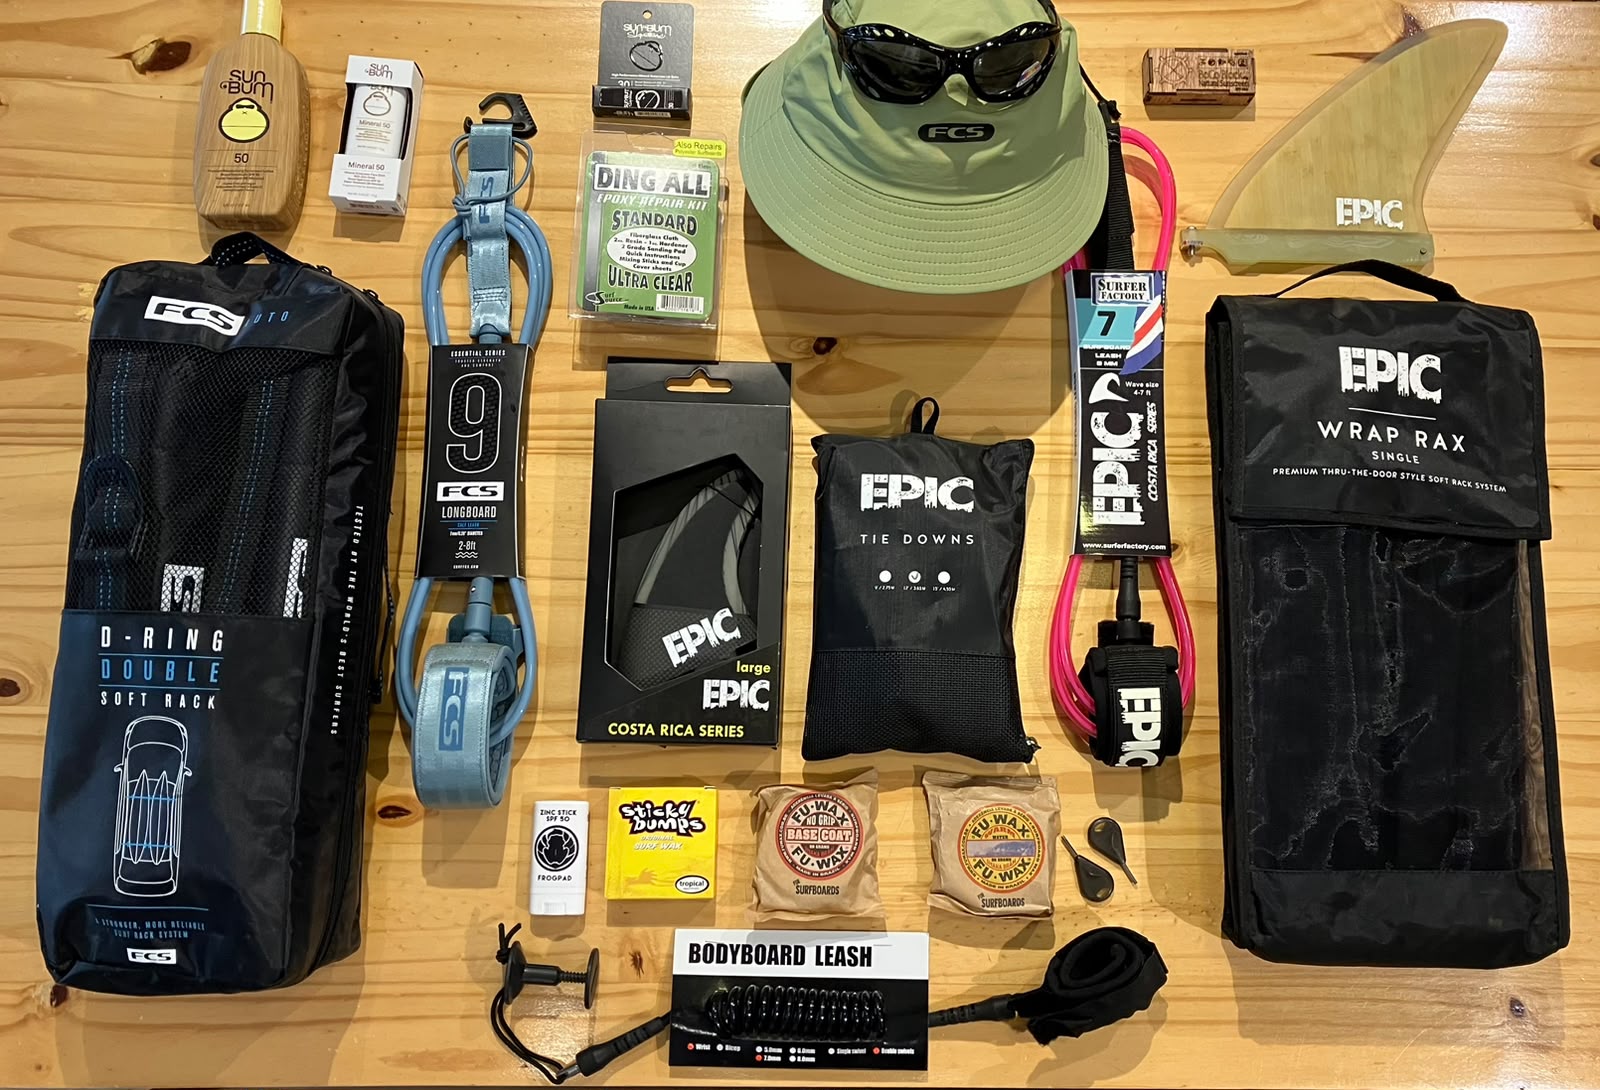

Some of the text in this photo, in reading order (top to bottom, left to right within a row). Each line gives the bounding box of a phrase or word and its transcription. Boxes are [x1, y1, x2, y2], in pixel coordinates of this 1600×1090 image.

[359, 119, 381, 127] Mineral
[928, 127, 985, 138] FCS
[694, 142, 722, 151] Repairs
[234, 153, 249, 164] 50
[348, 161, 375, 170] Mineral
[597, 167, 708, 196] DING ALL
[478, 176, 494, 223] FS
[596, 193, 636, 205] EPOXY
[687, 200, 708, 211] KIT
[612, 210, 697, 236] STANDARD
[1336, 197, 1404, 230] EPIC
[644, 252, 680, 260] Instructions
[647, 246, 672, 254] Sanding
[608, 265, 692, 292] ULTRA CLEAR
[1098, 280, 1147, 291] SURFER
[1101, 292, 1145, 300] FACTORY
[153, 302, 235, 330] FCS
[1097, 311, 1116, 336] 7
[1338, 346, 1442, 404] EPIC
[446, 372, 502, 474] 9
[1317, 421, 1466, 453] WRAP RAX
[1146, 401, 1158, 502] COSTA RICA SERIES
[1372, 450, 1420, 464] SINGLE
[1091, 411, 1145, 526] EPIC
[1272, 467, 1507, 493] PREMIUM THRU-THE-DOOR STYLE SOFT RACK SYSTEM
[442, 485, 498, 497] FCS
[860, 473, 975, 513] EPIC
[441, 506, 497, 518] LONGBOARD
[353, 505, 364, 544] TESTED
[458, 540, 476, 550] 2-8ft
[860, 534, 975, 545] TIE DOWNS
[1082, 541, 1167, 551] www.surferfactory.com
[348, 570, 357, 589] THE
[101, 625, 224, 652] D-RING
[662, 607, 741, 668] EPIC
[101, 658, 220, 683] DOUBLE
[736, 660, 771, 676] large
[100, 691, 215, 710] SOFT RACK
[702, 679, 771, 712] EPIC
[330, 685, 342, 735] SURFERS
[443, 671, 466, 745] FCS
[608, 722, 744, 738] COSTA RICA SERIES
[1115, 687, 1161, 767] EPIC
[806, 814, 836, 825] NO GRIP
[787, 829, 852, 841] BASE COAT
[679, 881, 705, 889] tropical
[795, 885, 840, 895] SURFBOARDS
[981, 898, 1025, 908] SURFBOARDS
[131, 952, 172, 961] FCS
[689, 943, 873, 967] BODYBOARD LEASH
